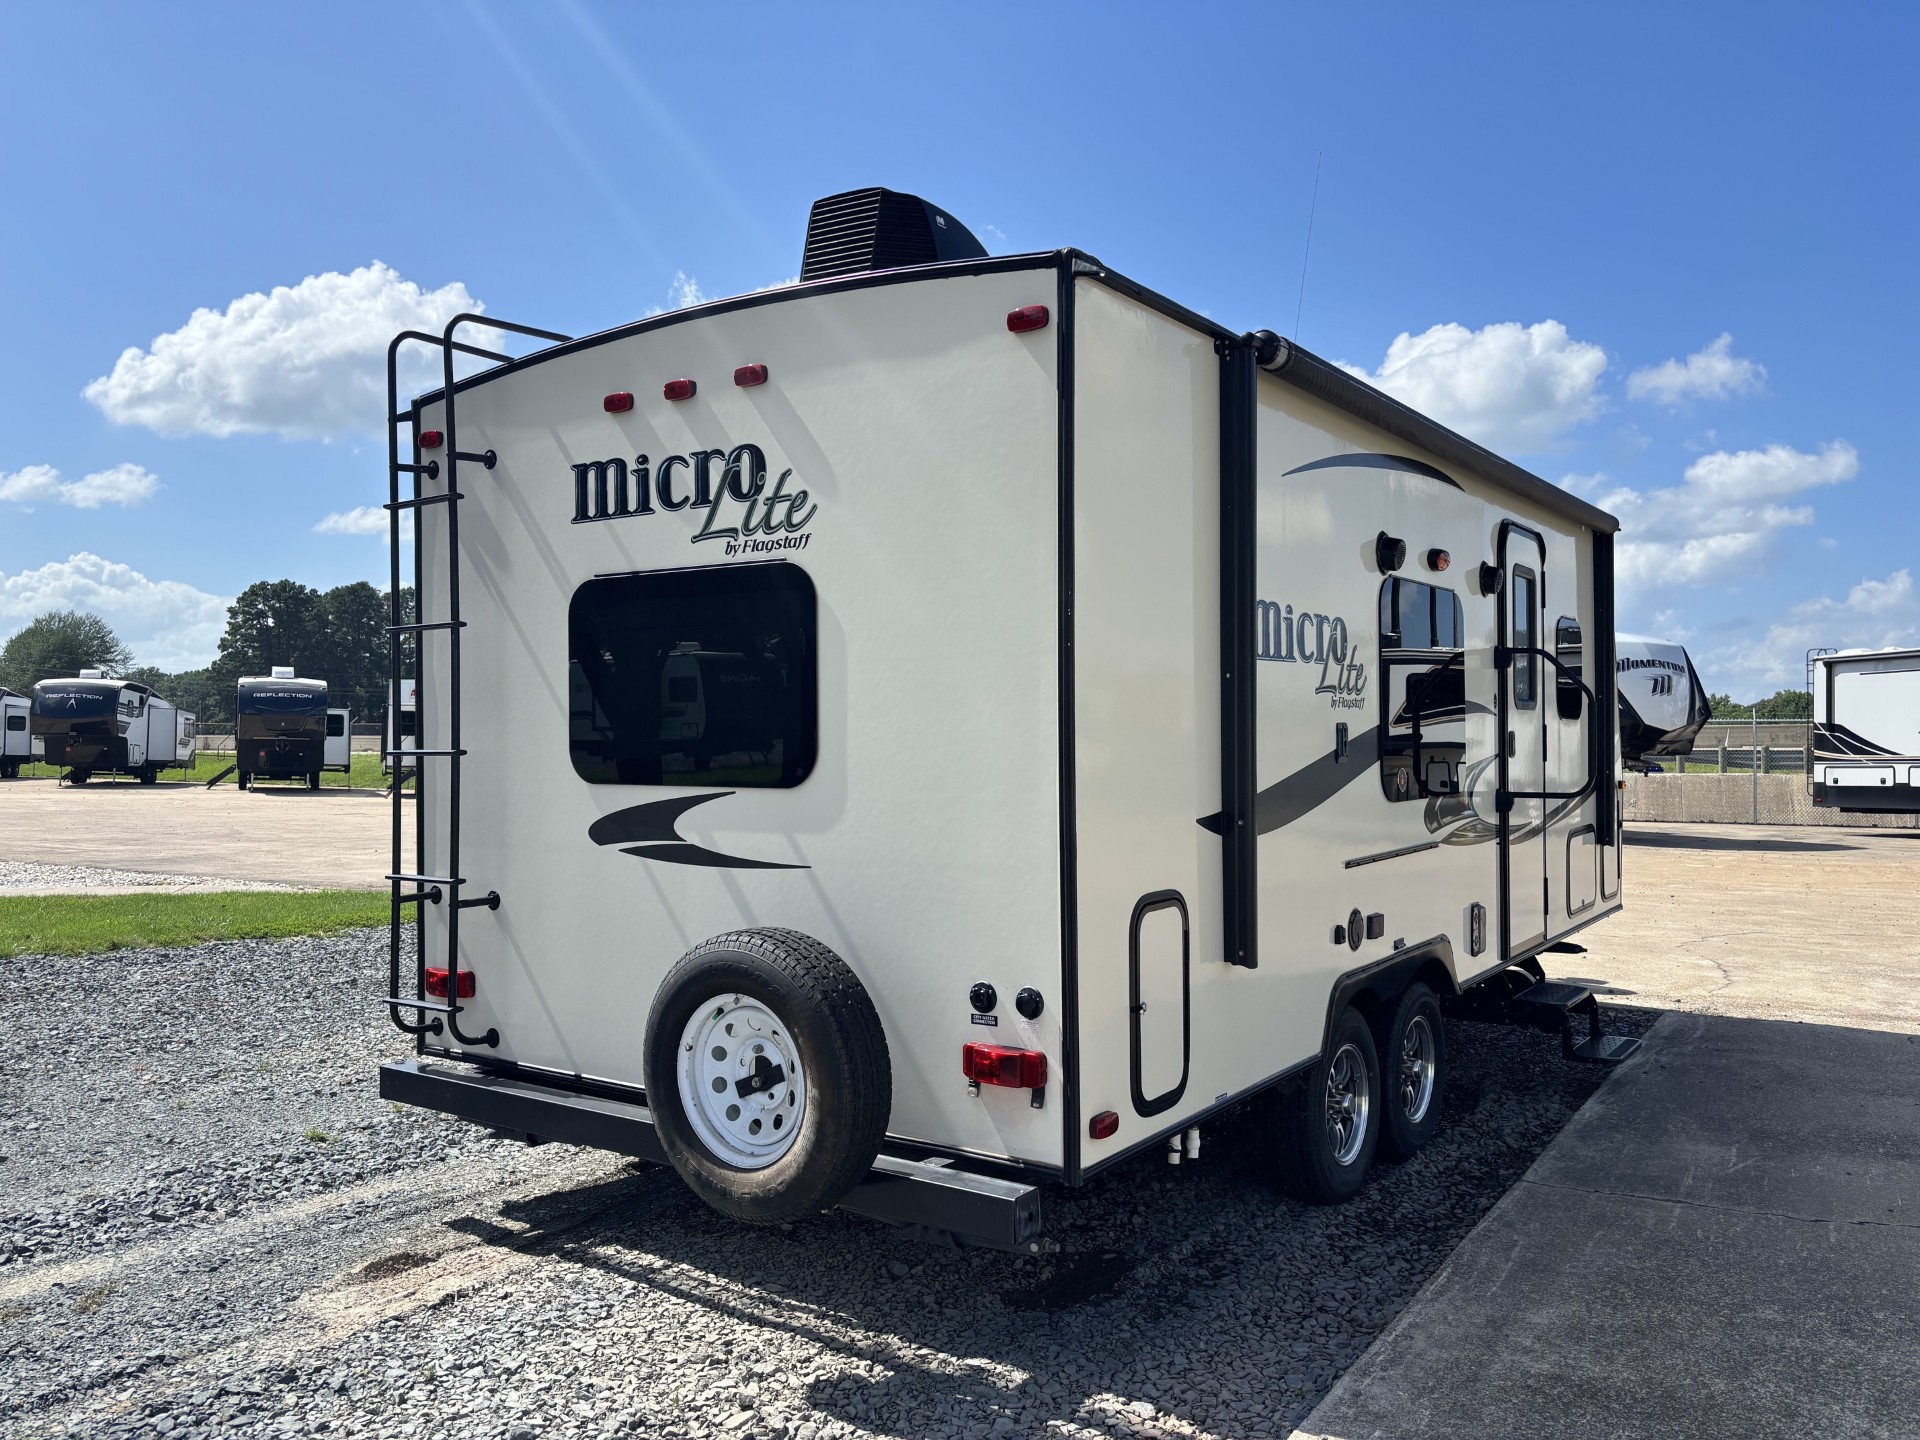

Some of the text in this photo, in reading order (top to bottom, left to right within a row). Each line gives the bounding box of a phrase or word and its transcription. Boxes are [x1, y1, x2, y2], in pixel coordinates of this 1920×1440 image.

[570, 443, 767, 524] micro
[691, 463, 818, 544] Lite
[725, 533, 812, 557] by Flagstaff
[1256, 599, 1348, 665] micro
[1315, 631, 1367, 696] Lite
[45, 692, 104, 701] REFLECTION
[253, 691, 313, 699] REFLECTION
[1331, 696, 1366, 711] by Flagstaff
